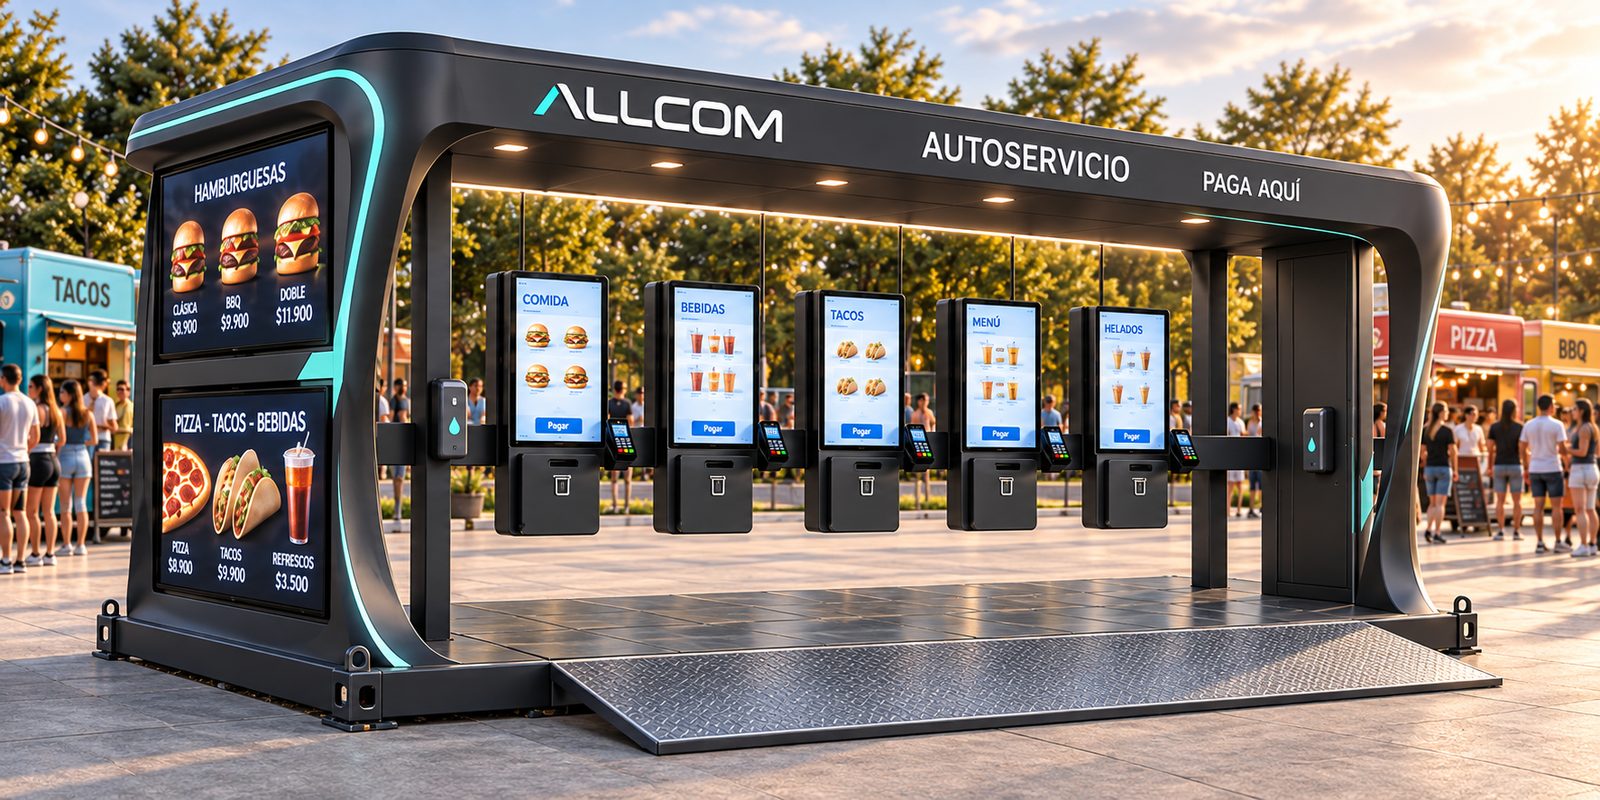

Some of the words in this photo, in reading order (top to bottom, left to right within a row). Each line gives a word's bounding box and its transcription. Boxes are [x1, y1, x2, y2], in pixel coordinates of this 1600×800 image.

[533, 83, 783, 143] ALLCOM
[921, 131, 1130, 183] AUTOSERVICIO
[194, 161, 286, 203] HAMBURGUESAS
[1203, 170, 1252, 196] PAGA
[1258, 177, 1301, 202] AQUÍ
[52, 275, 110, 308] TACOS
[280, 285, 306, 301] DOBLE
[522, 293, 569, 307] COMIDA
[173, 301, 198, 316] CLÁSICA
[225, 295, 241, 310] BBQ
[681, 301, 725, 315] BEBIDAS
[221, 312, 249, 332] $9.900
[275, 304, 313, 326] $11.900
[830, 309, 864, 322] TACOS
[972, 315, 1001, 328] MENÚ
[172, 319, 198, 338] $8.900
[1104, 323, 1143, 335] HELADOS
[1451, 324, 1497, 352] PIZZA
[1559, 338, 1588, 363] BBQ
[175, 414, 202, 433] PIZZA
[212, 412, 246, 433] TACOS
[257, 411, 306, 433] BEBIDAS
[172, 540, 189, 555] PIZZA
[220, 546, 242, 561] TACOS
[168, 557, 193, 575] $8.900
[272, 551, 314, 570] REFRESCOS
[217, 563, 246, 583] $9.900
[275, 571, 309, 593] $3.500
